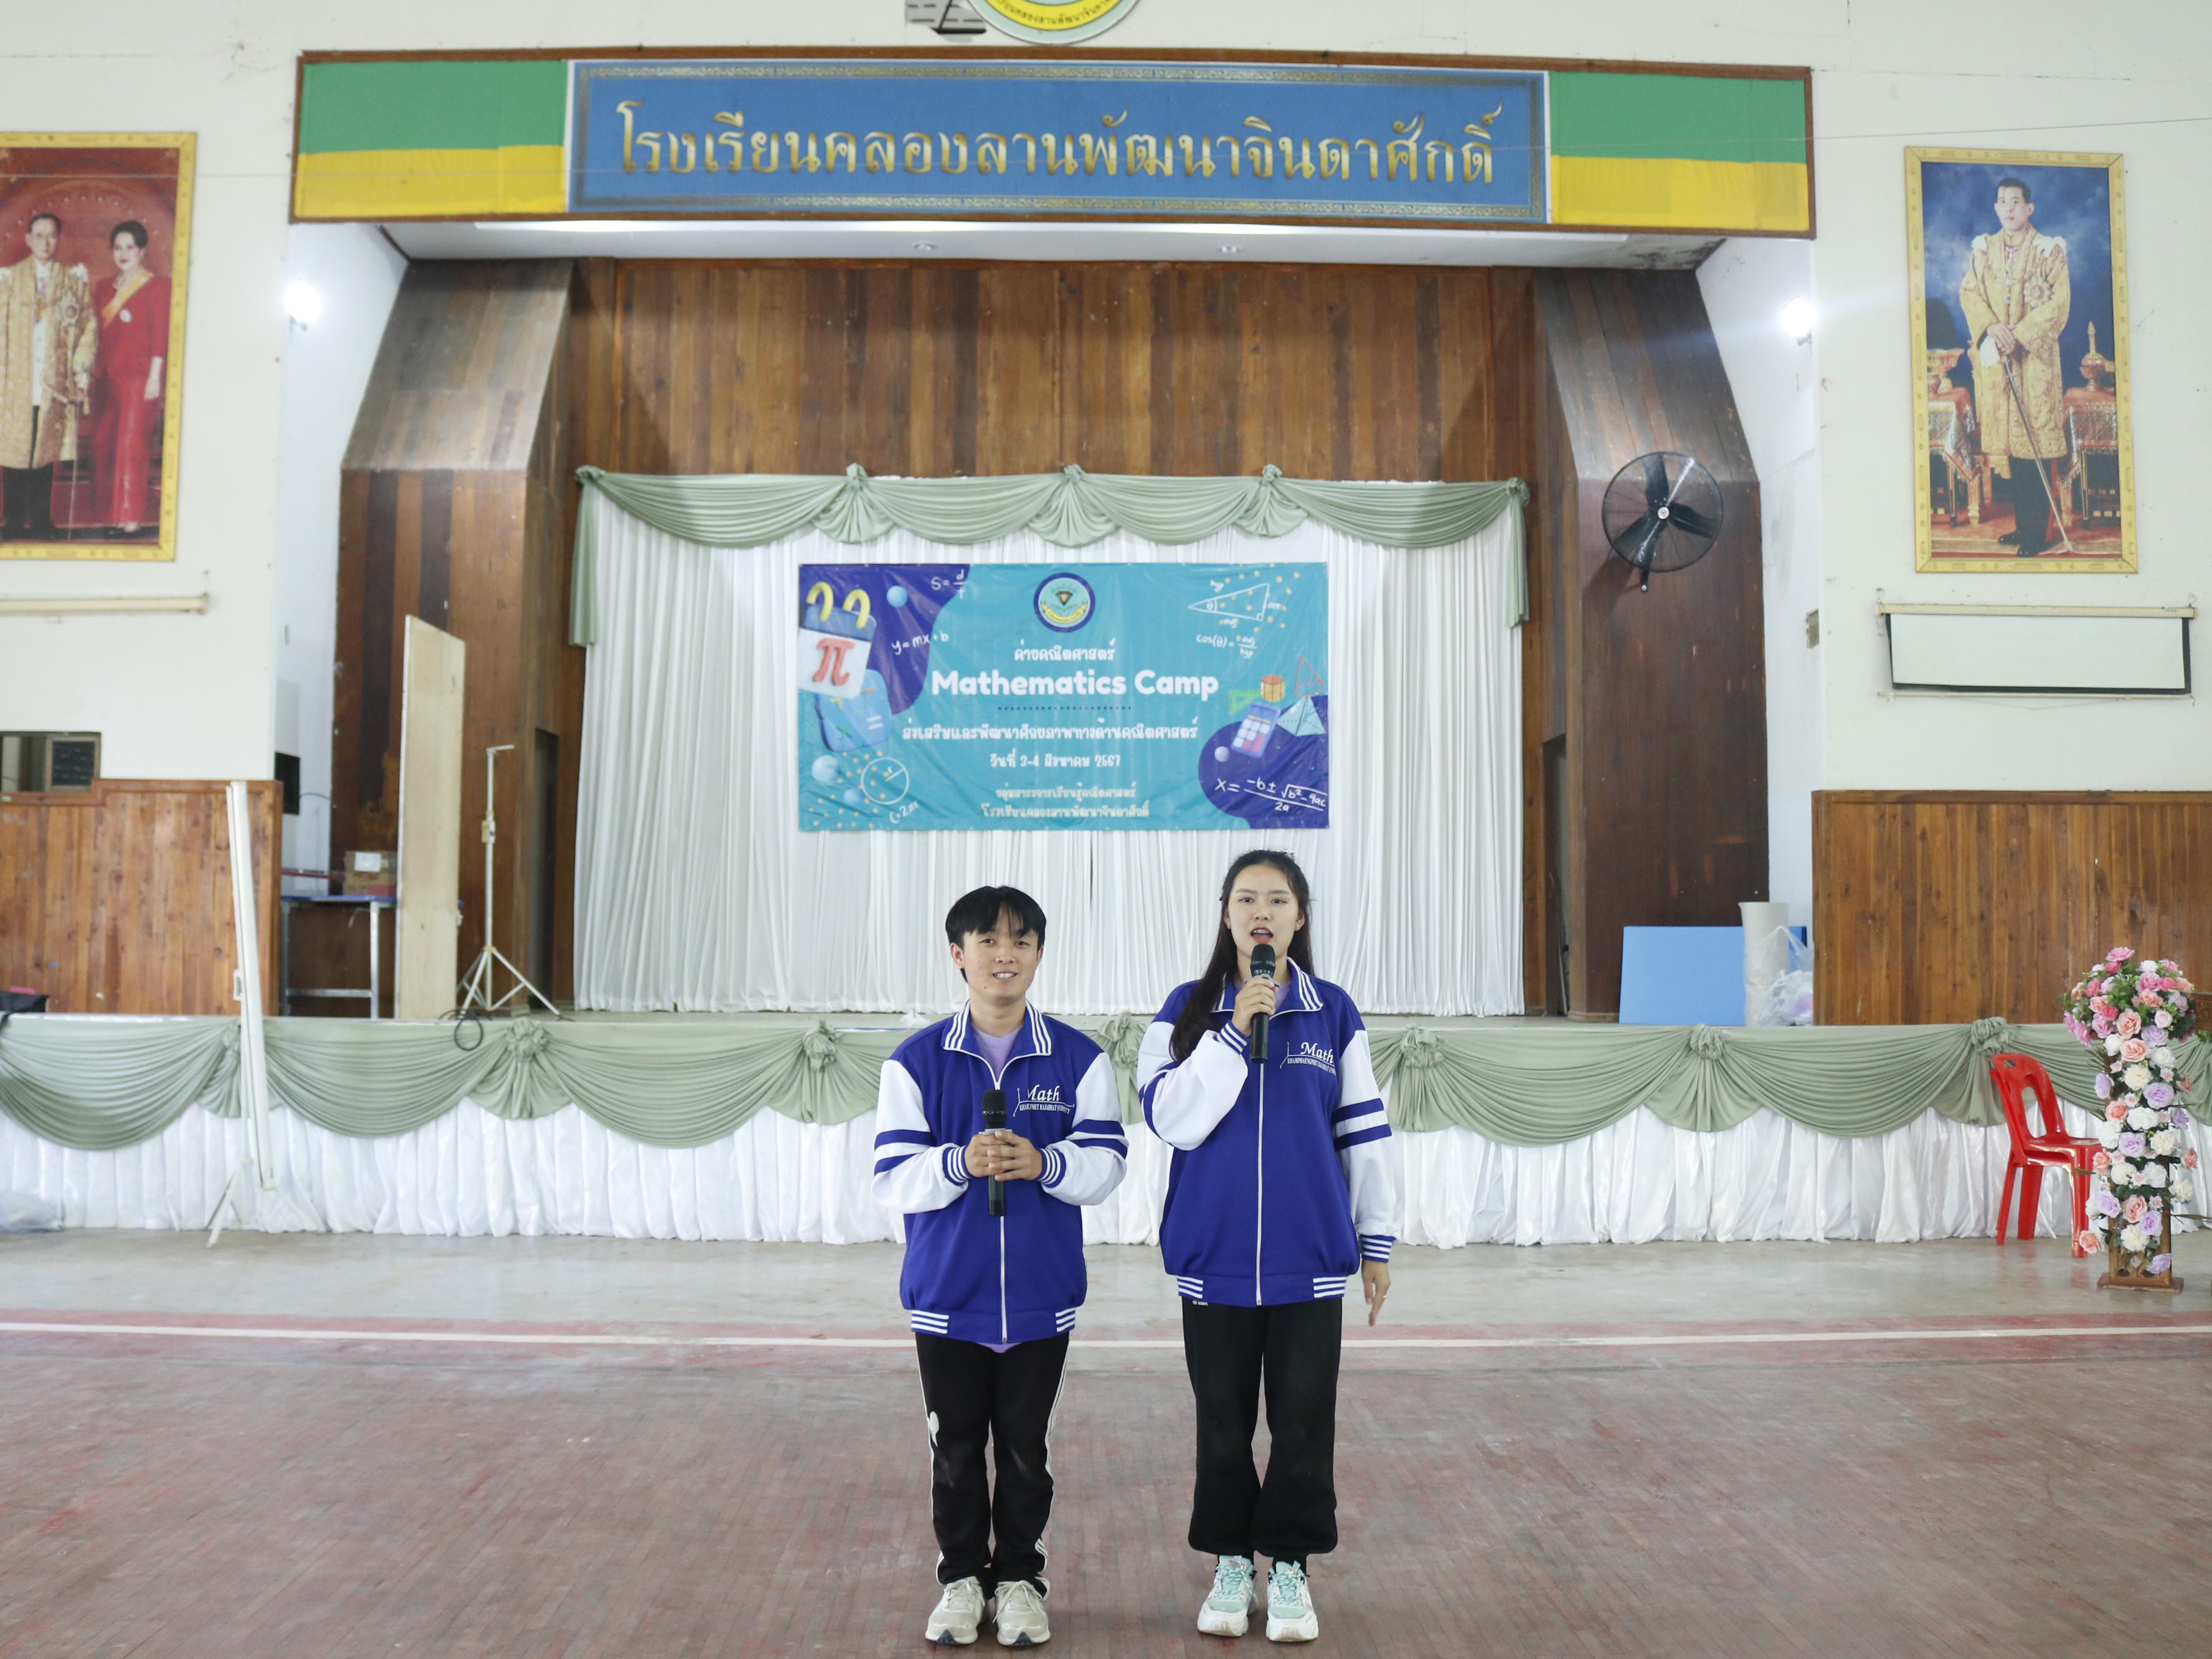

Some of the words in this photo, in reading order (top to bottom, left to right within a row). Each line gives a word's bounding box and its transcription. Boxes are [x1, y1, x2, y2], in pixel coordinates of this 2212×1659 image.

[617, 98, 1503, 184] โรงเรียนคลองลานพัฒนาจินดาศักดิ์
[1014, 638, 1116, 661] ค่ายคณิตศาสตร์
[932, 669, 1126, 696] Mathematics
[1135, 669, 1219, 702] Camp
[990, 748, 1016, 768] วันที่
[1044, 752, 1090, 768] สิงหาคม
[1094, 754, 1121, 768] 2567
[1300, 1042, 1334, 1064] Math
